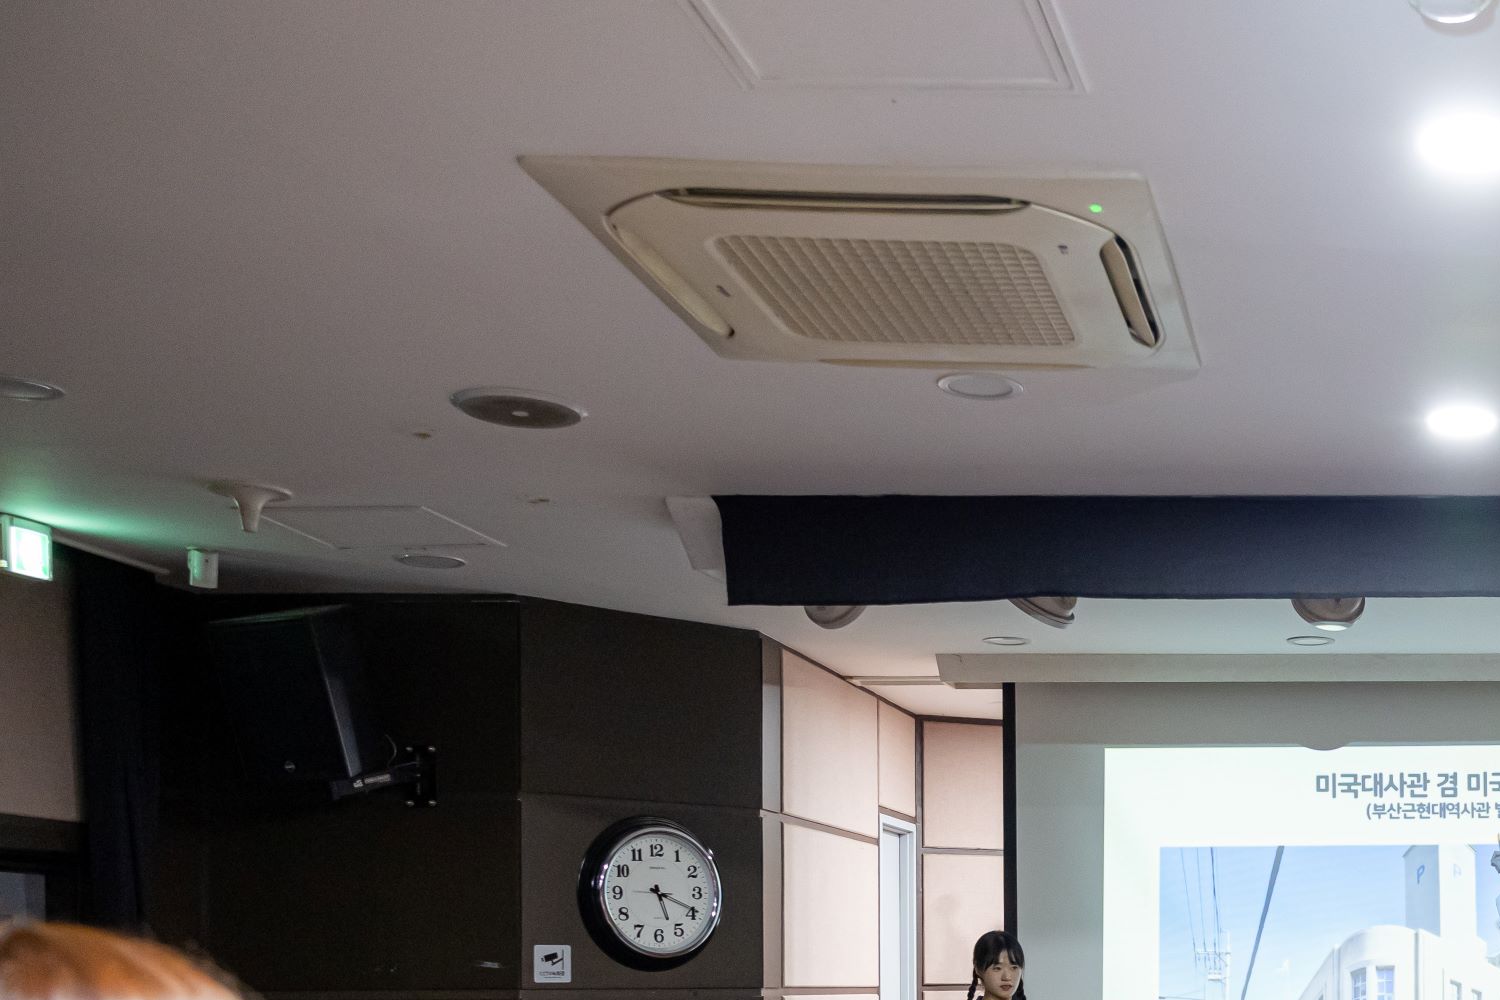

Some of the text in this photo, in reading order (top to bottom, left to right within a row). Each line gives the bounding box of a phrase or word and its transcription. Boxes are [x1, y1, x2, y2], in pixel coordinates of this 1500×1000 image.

[1316, 772, 1430, 798] 미국대사관
[1437, 772, 1458, 798] 겸
[1367, 802, 1491, 820] (부산근현대역사관
[630, 848, 643, 862] 11
[649, 843, 665, 858] 12
[674, 849, 681, 863] 1
[615, 864, 630, 878] 10
[687, 865, 698, 879] 2
[612, 885, 624, 900] 9
[691, 886, 703, 900] 3
[618, 906, 630, 921] 8
[685, 905, 698, 921] 4
[633, 924, 645, 938] 7
[653, 928, 665, 944] 6
[673, 922, 685, 938] 5
